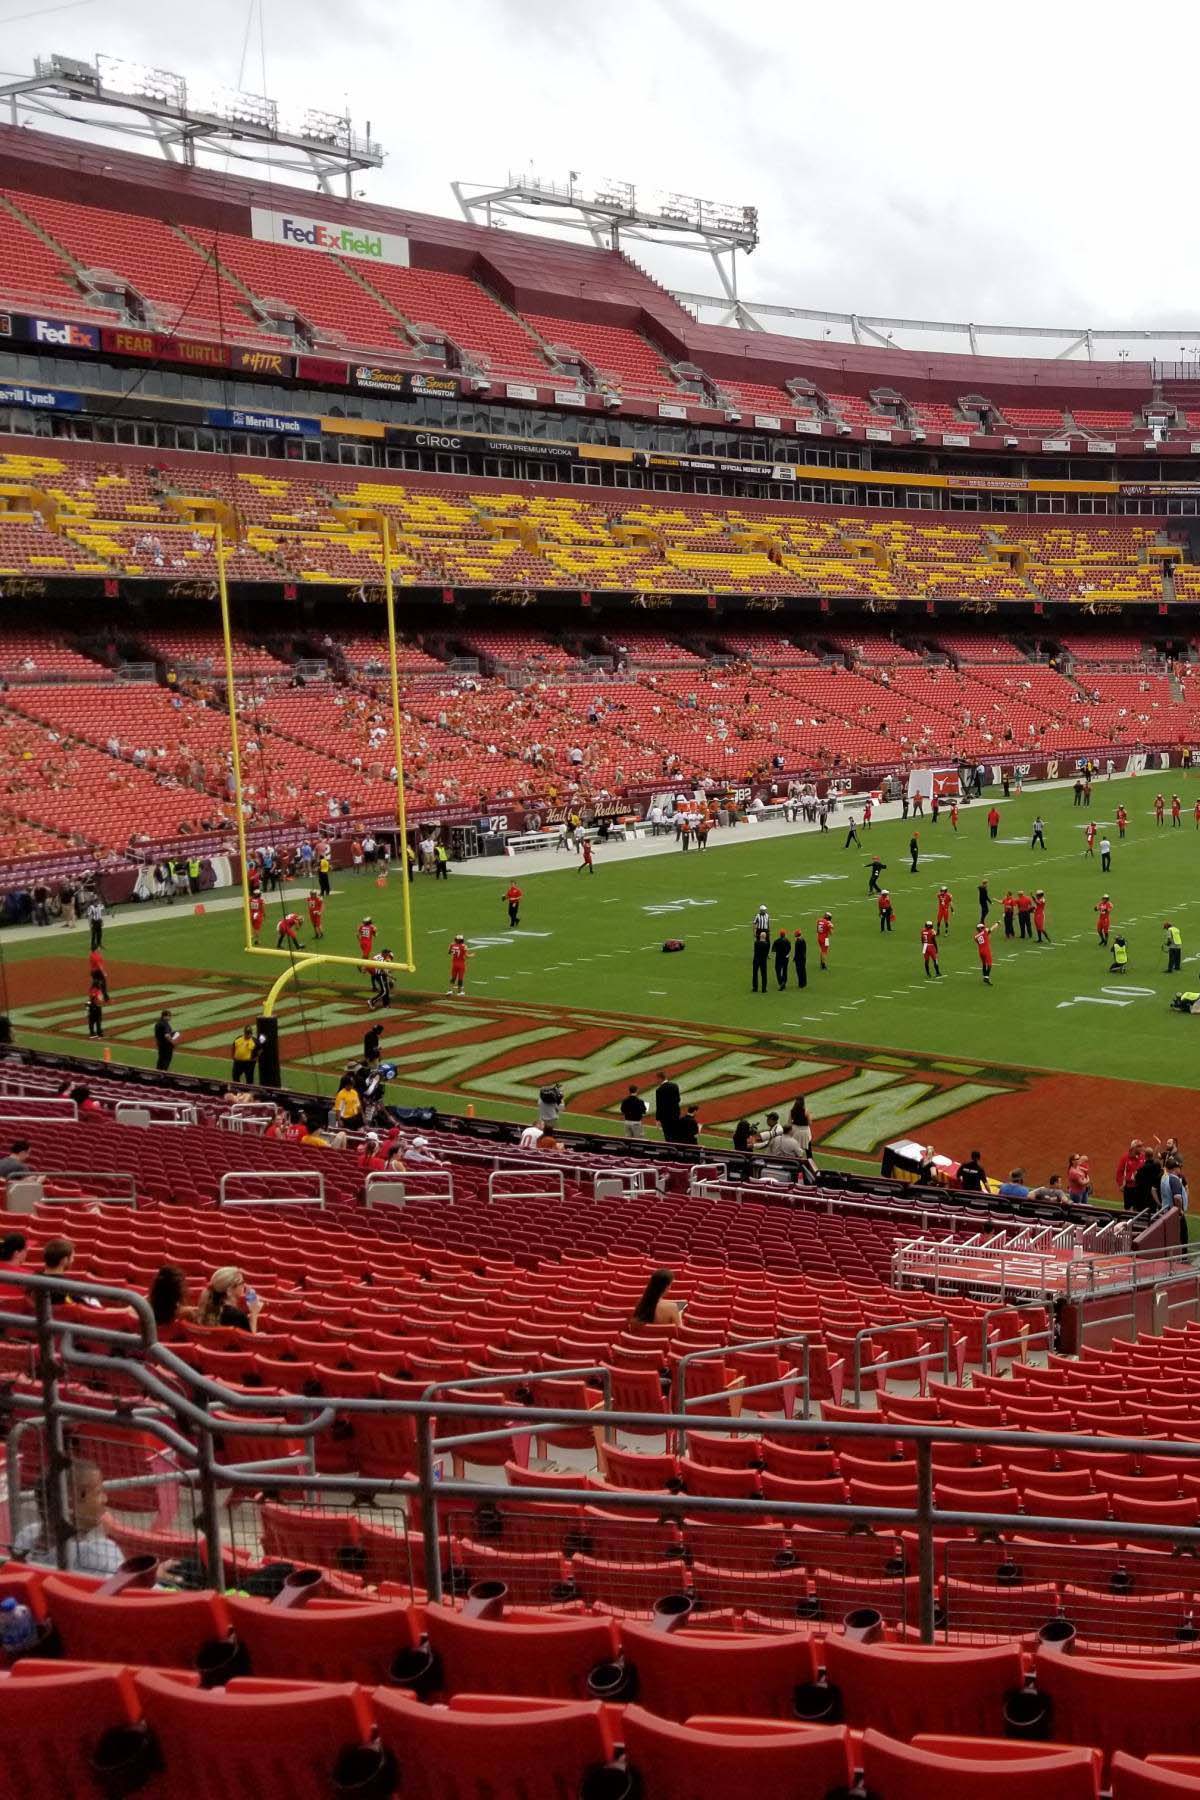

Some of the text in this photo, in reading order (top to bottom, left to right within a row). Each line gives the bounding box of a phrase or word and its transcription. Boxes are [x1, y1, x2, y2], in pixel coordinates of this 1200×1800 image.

[282, 218, 383, 258] FedExField
[36, 320, 93, 347] FedEx
[116, 335, 153, 352] FEAR
[371, 368, 403, 383] Sports
[426, 376, 457, 390] Sports
[358, 379, 401, 391] WASHINGTON
[412, 386, 455, 398] WASHINGTON
[245, 415, 300, 431] Merrill Lynch
[593, 802, 632, 821] Redskins
